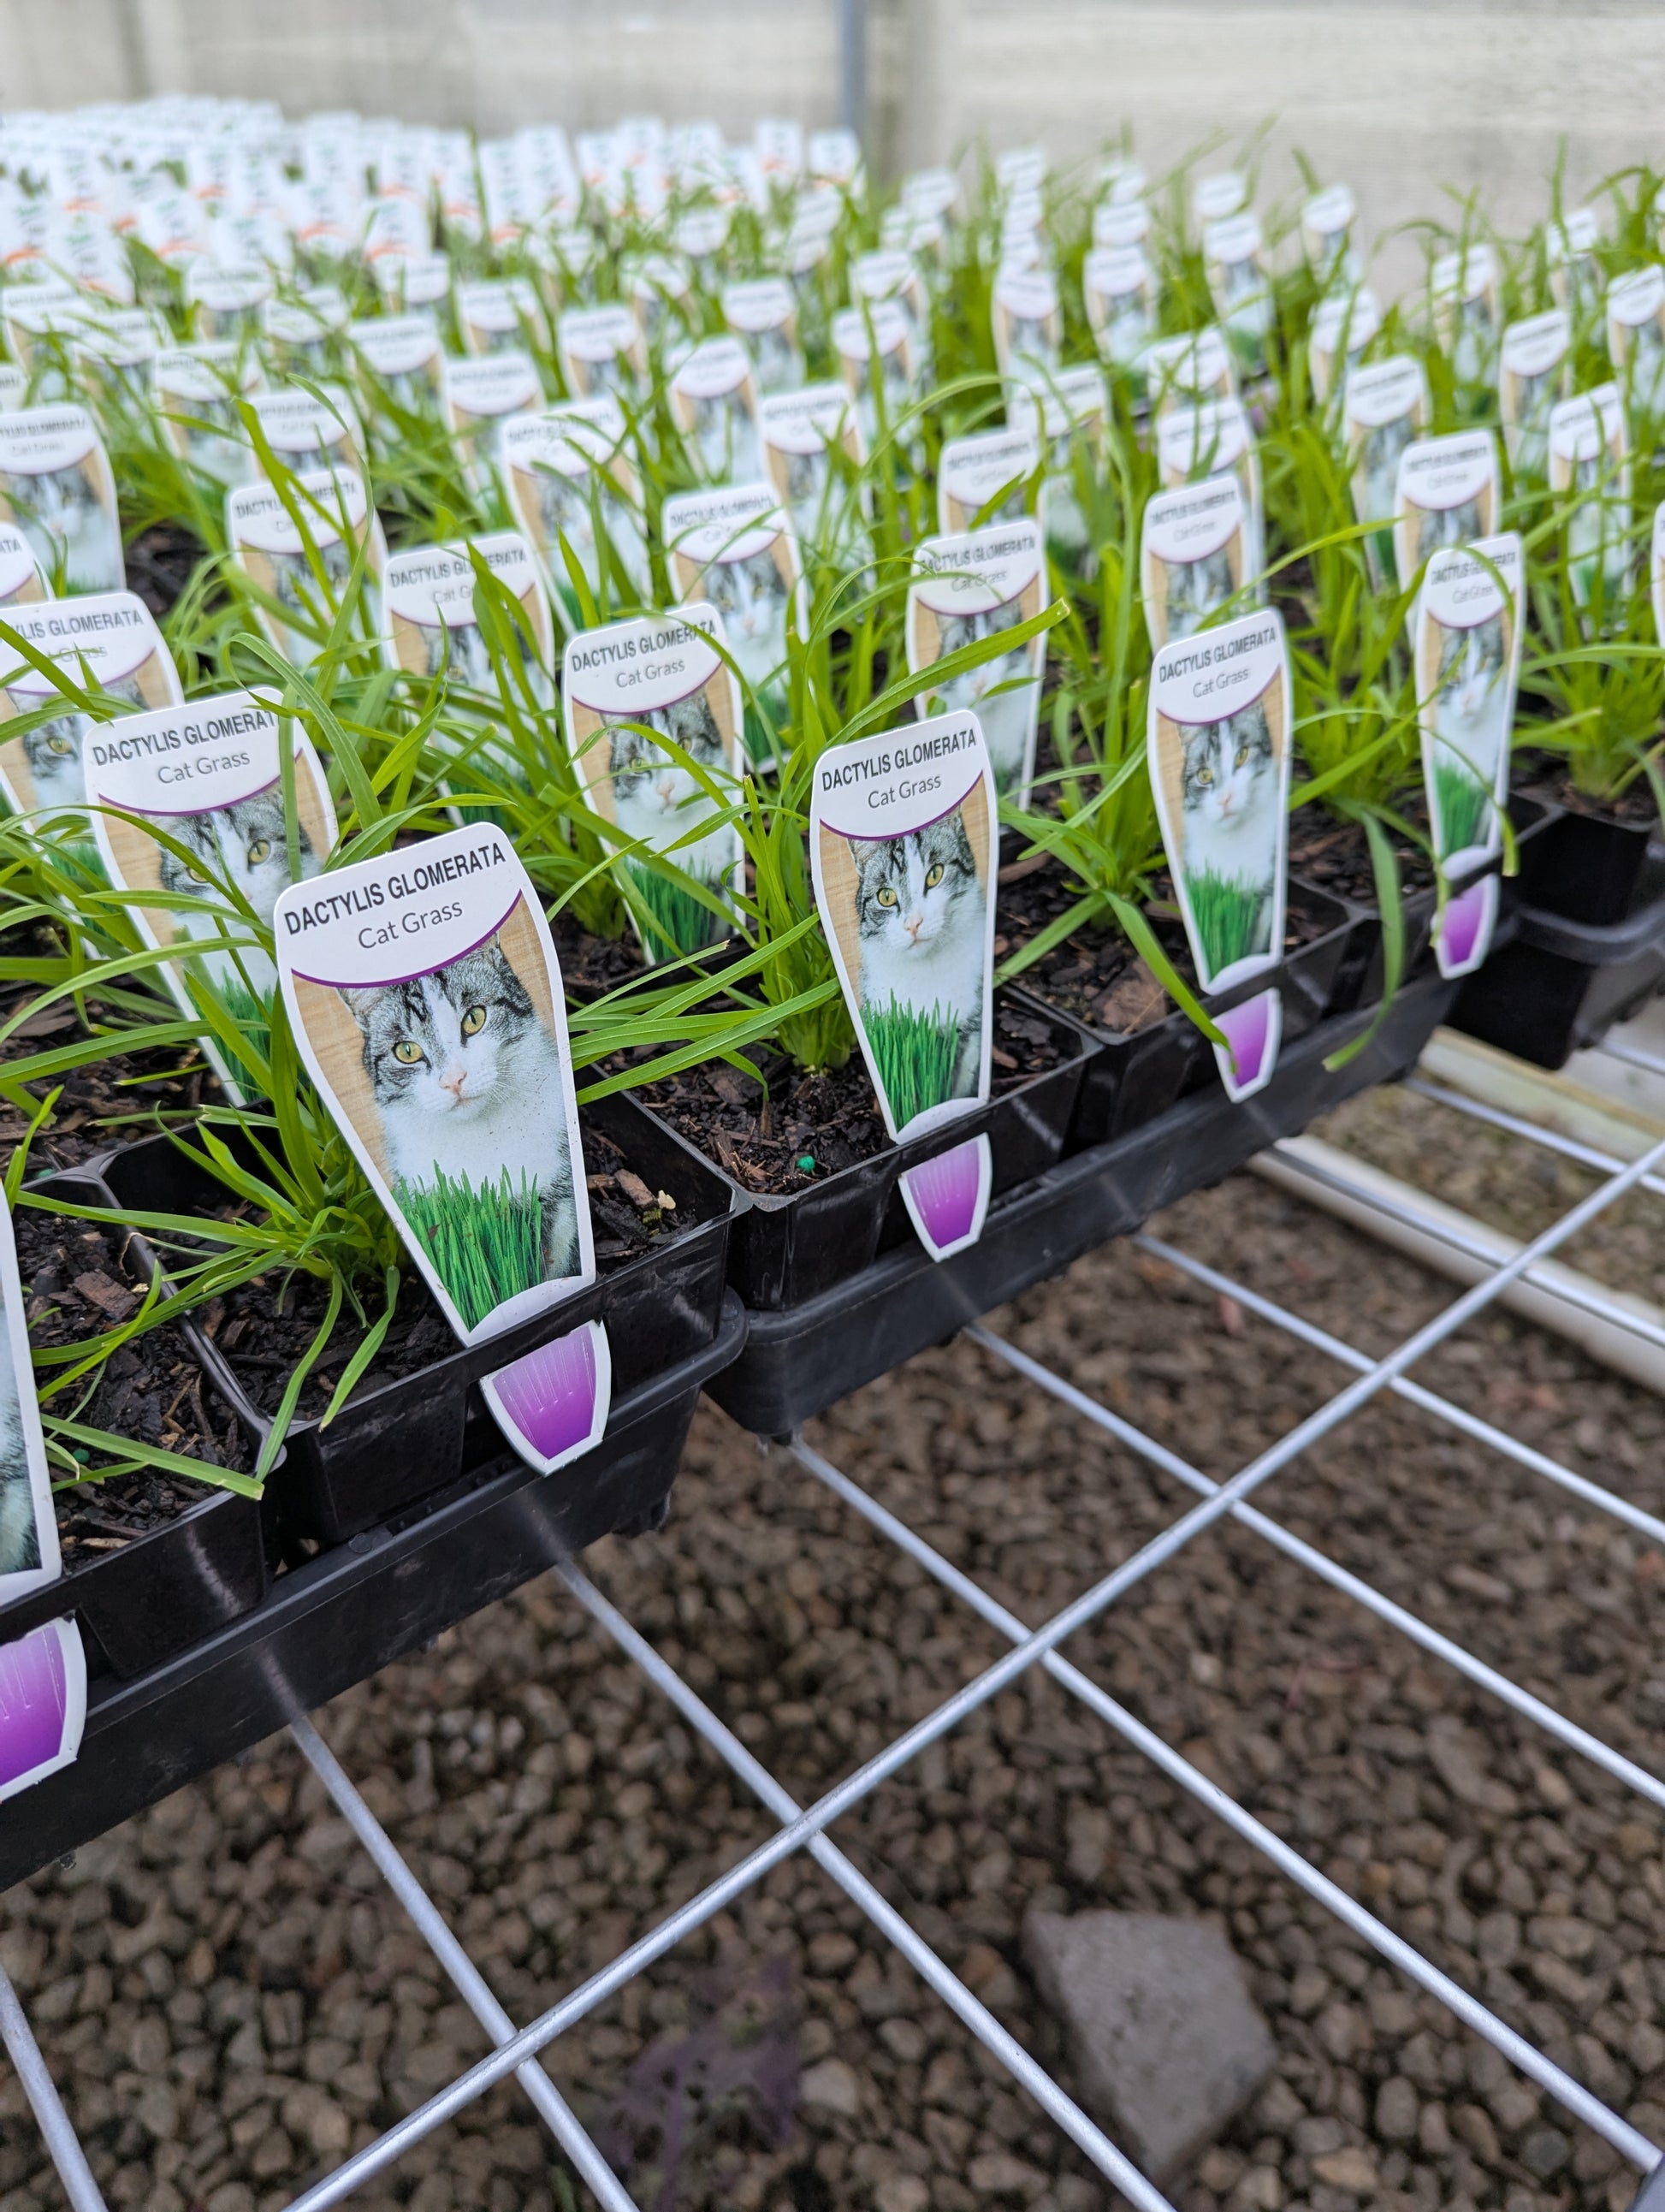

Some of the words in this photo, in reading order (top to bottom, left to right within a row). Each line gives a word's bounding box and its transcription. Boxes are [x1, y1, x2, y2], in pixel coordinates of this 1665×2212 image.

[390, 562, 451, 588] DACTYLIS
[433, 587, 456, 603] Cat
[49, 609, 144, 637] GLOMERATA
[572, 641, 637, 673] DACTYLIS
[1159, 650, 1212, 683] DACTYLIS
[1213, 627, 1277, 663] GLOMERATA
[616, 668, 643, 689] Cat
[645, 660, 685, 680] Grass
[1193, 680, 1215, 698] Cat
[1216, 668, 1250, 690] Grass
[92, 730, 181, 766] DACTYLIS
[184, 711, 276, 745] GLOMERAT
[157, 765, 193, 784] Cat
[196, 751, 251, 775] Grass
[821, 754, 892, 792] DACTYLIS
[894, 729, 976, 770] GLOMERATA
[868, 786, 896, 809] Cat
[898, 774, 941, 799] Grass
[284, 882, 385, 935] DACTYLIS
[388, 842, 507, 899] GLOMERATA
[358, 921, 400, 949] Cat
[401, 901, 463, 934] Grass
